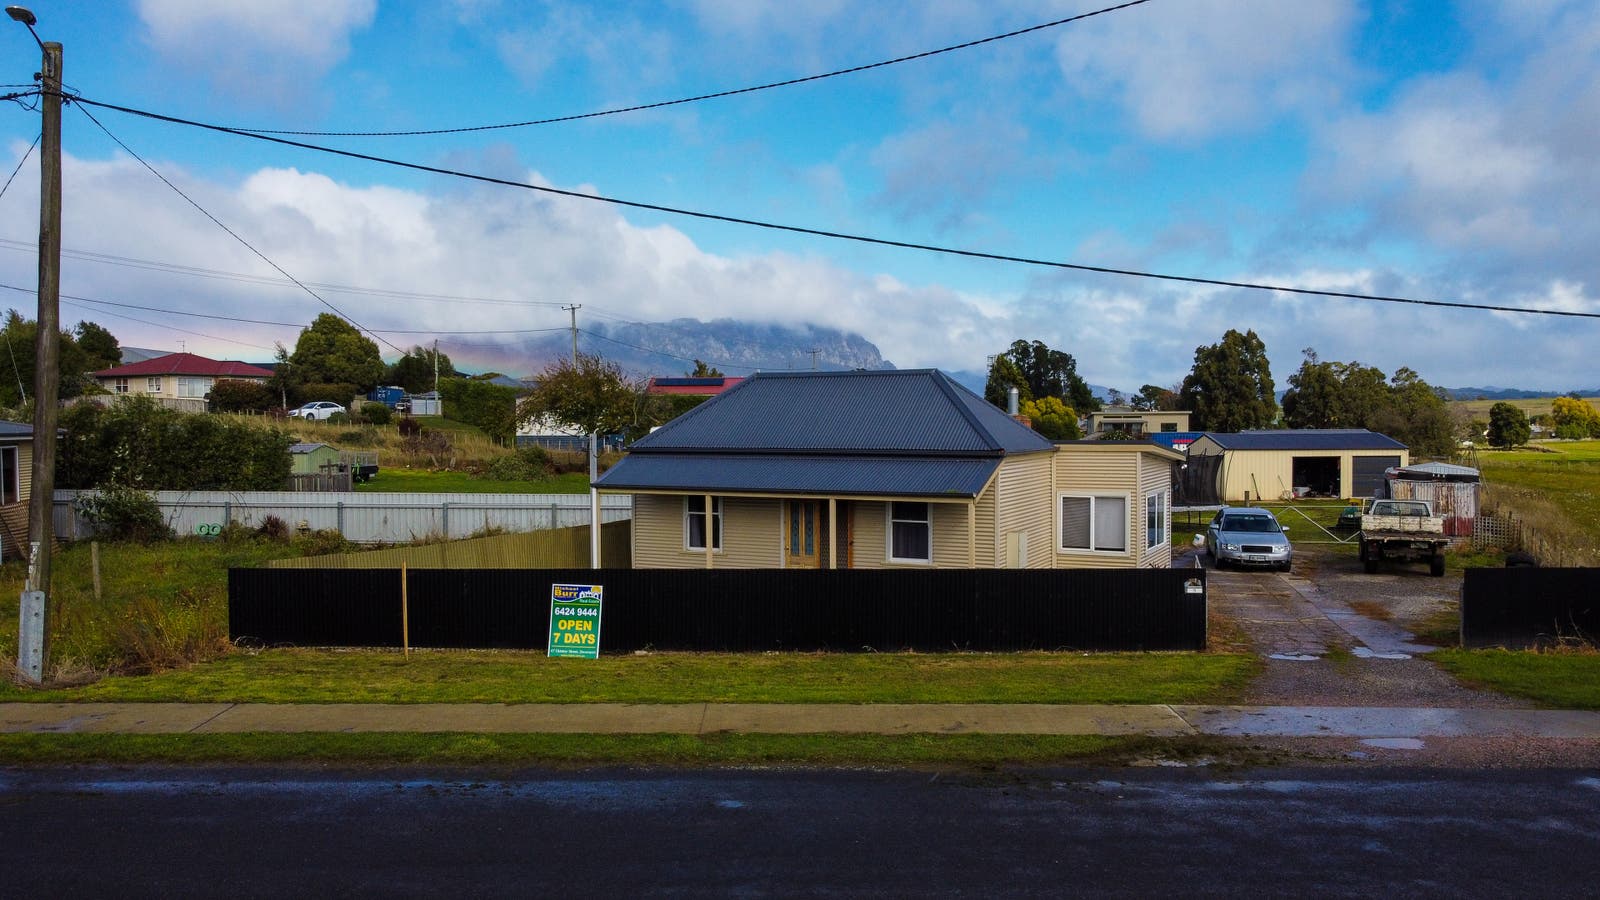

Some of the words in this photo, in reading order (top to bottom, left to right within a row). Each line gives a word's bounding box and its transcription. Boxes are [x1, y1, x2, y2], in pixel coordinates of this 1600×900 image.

[554, 607, 575, 616] 6424
[577, 608, 597, 616] 9444
[558, 620, 592, 631] OPEN
[553, 632, 561, 643] 7
[564, 633, 595, 644] DAYS
